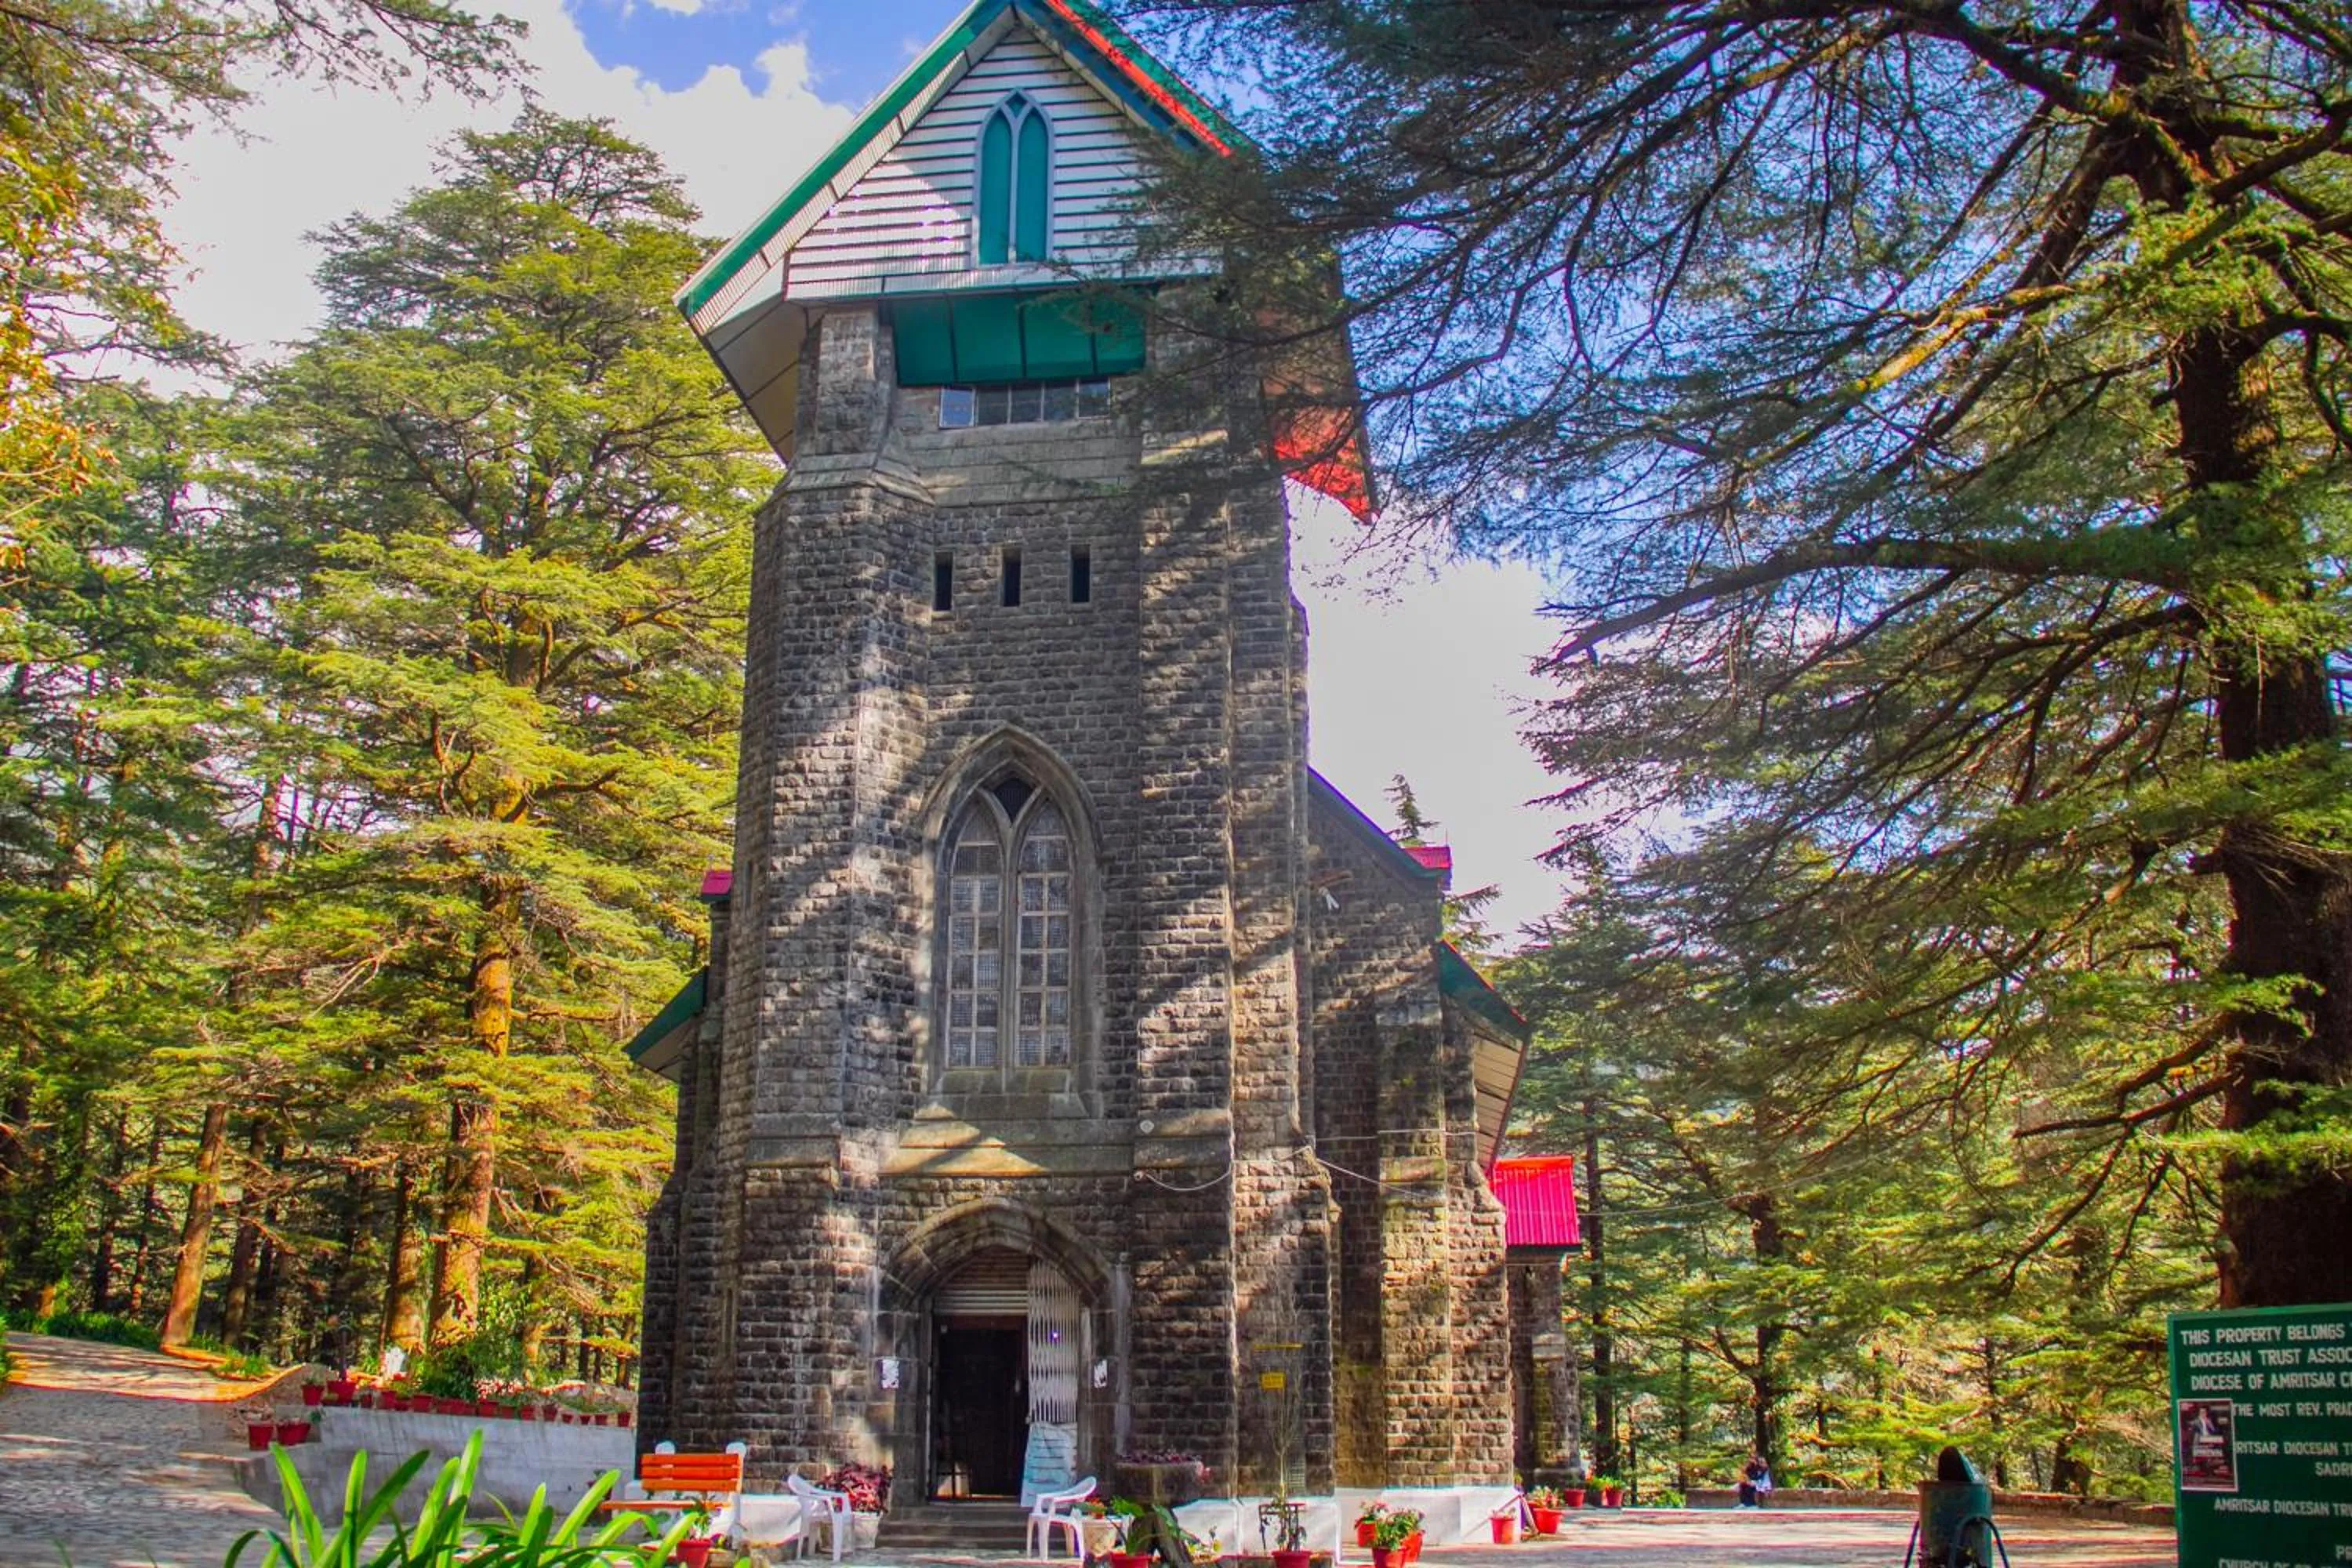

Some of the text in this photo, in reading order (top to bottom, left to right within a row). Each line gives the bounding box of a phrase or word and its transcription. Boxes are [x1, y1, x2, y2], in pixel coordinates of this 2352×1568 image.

[2180, 1323, 2345, 1345] THIS PROPERTY BELONGS
[2189, 1351, 2252, 1367] DIOCESAN
[2258, 1348, 2301, 1365] TRUST
[2190, 1374, 2243, 1390] DIOCESE
[2248, 1374, 2264, 1388] OF
[2270, 1372, 2336, 1388] AMRITSAR
[2232, 1403, 2254, 1416] THE
[2259, 1403, 2290, 1416] MOST
[2296, 1402, 2324, 1416] REV.
[2283, 1442, 2339, 1455] DIOCESAN
[2214, 1498, 2270, 1513] AMRITSAR
[2274, 1500, 2330, 1515] DIOCESAN
